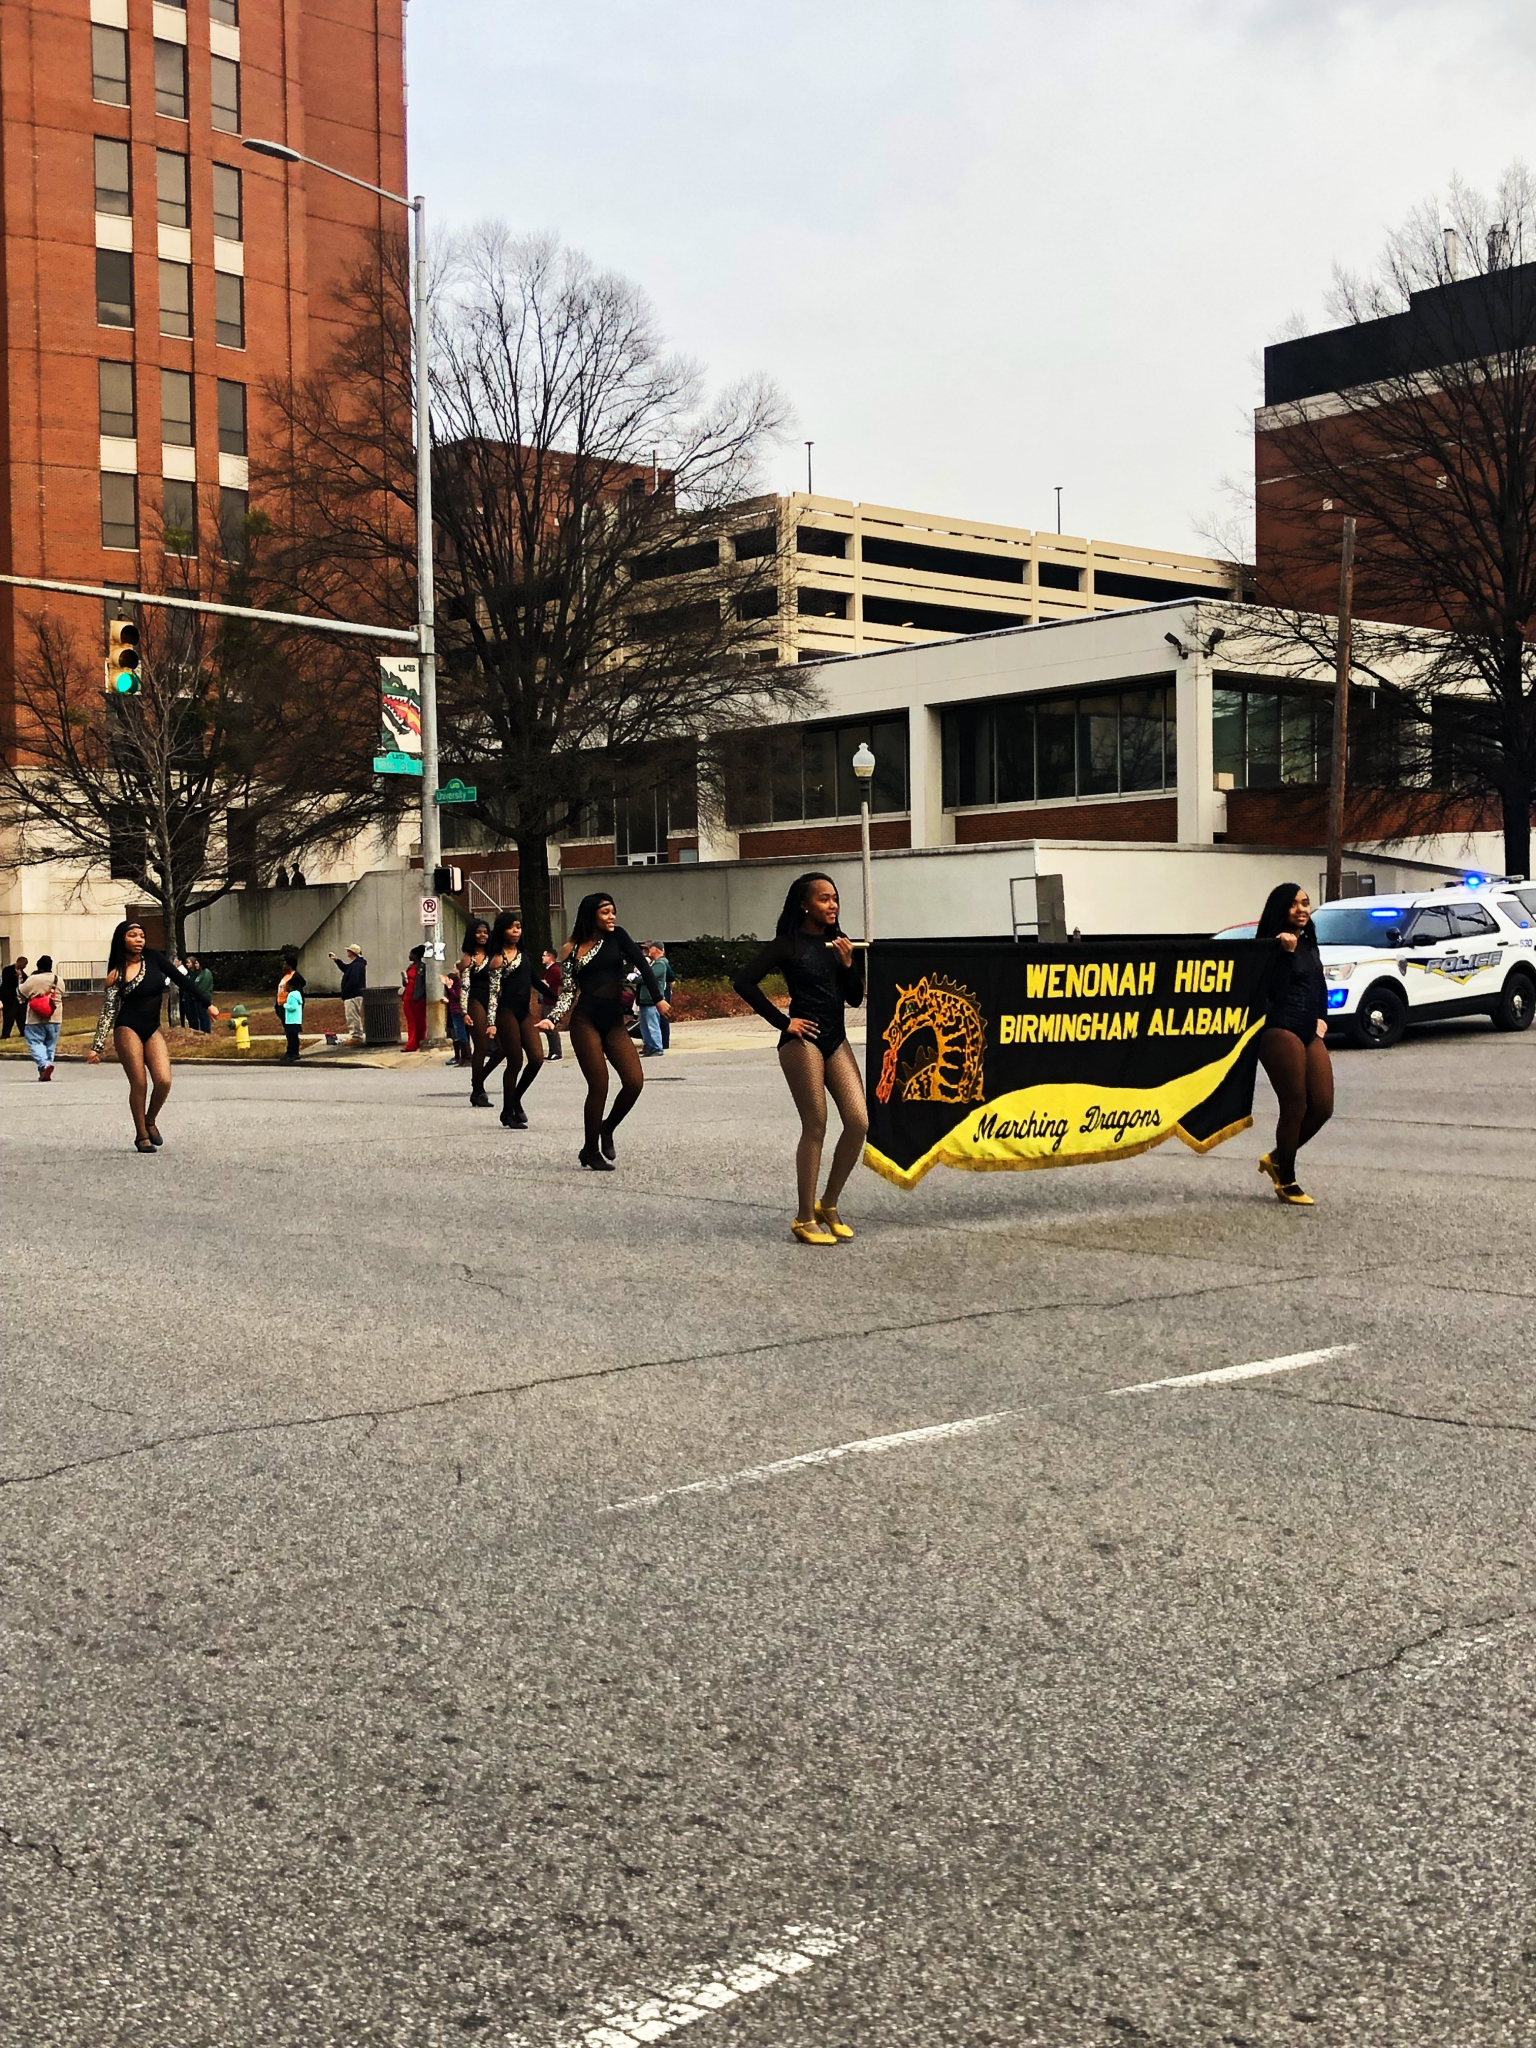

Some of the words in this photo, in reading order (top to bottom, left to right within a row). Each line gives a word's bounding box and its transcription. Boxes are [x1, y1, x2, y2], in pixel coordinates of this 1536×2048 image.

[437, 790, 467, 801] University
[1425, 950, 1503, 974] POLICE
[1026, 961, 1156, 998] WENONAH
[1174, 960, 1235, 993] HIGH
[1147, 1006, 1250, 1036] ALABAMA
[973, 1111, 1069, 1151] Marching
[1080, 1105, 1162, 1142] Dragons
